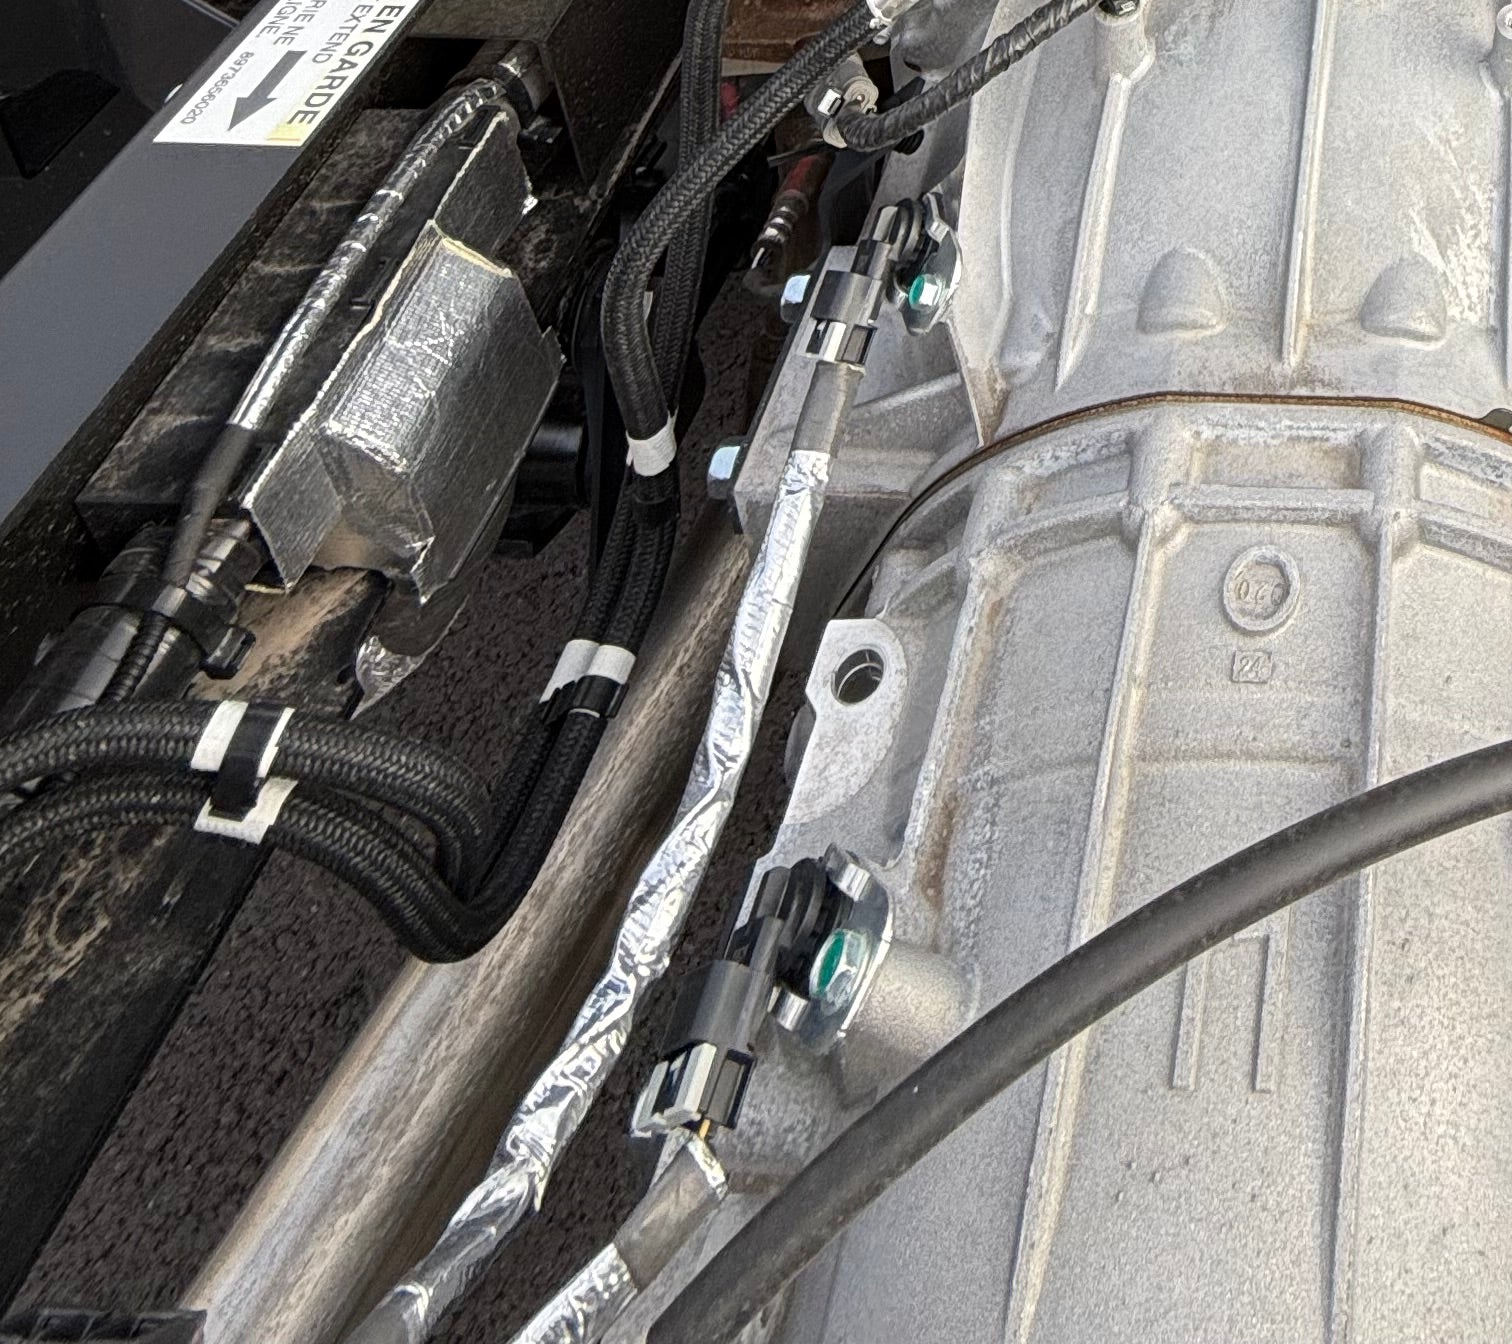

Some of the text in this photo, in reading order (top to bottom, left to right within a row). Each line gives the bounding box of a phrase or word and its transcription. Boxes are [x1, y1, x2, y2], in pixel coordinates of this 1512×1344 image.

[273, 26, 304, 45] NE
[312, 5, 374, 63] EXTEND
[362, 5, 405, 33] EN
[287, 41, 374, 124] GARDE
